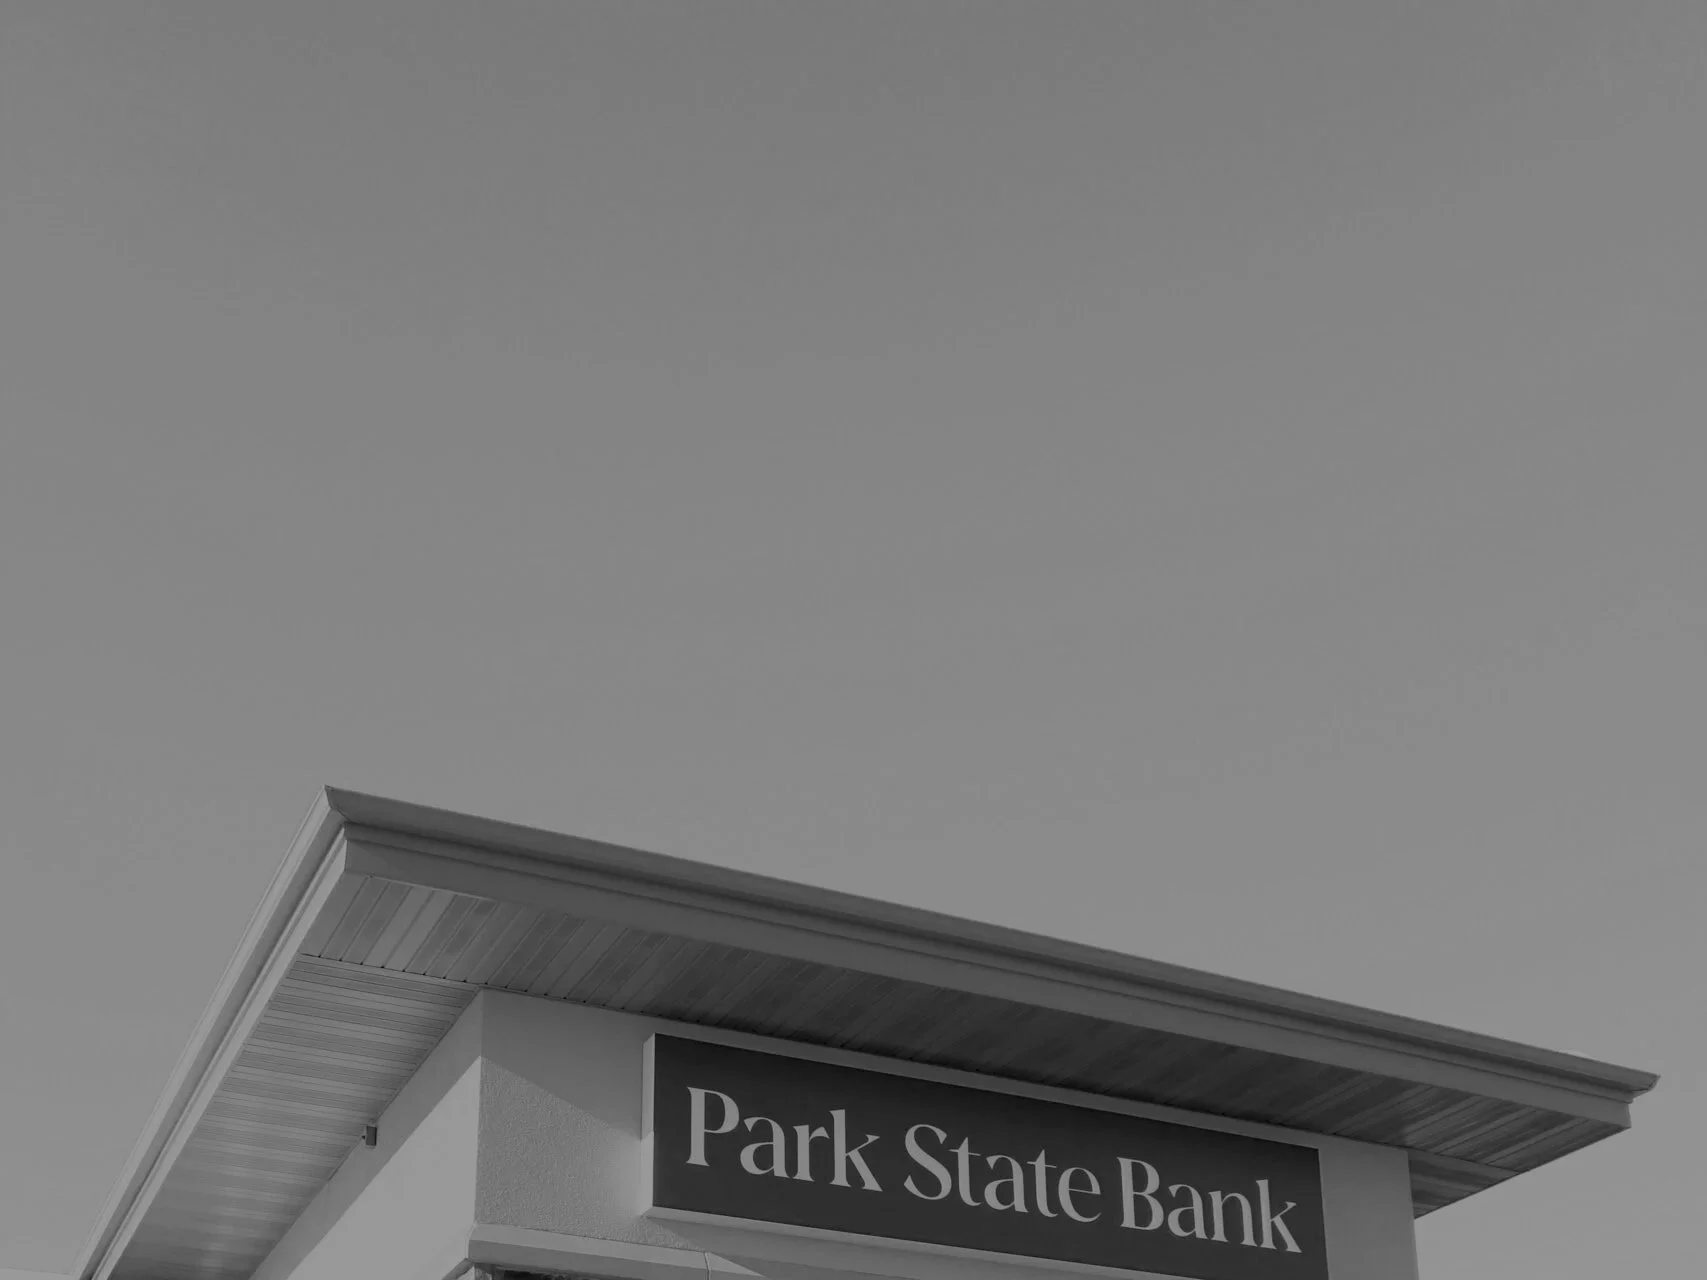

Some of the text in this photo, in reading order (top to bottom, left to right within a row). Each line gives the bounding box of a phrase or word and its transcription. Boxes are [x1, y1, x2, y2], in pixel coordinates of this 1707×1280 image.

[686, 1086, 1303, 1253] Park State Bank
